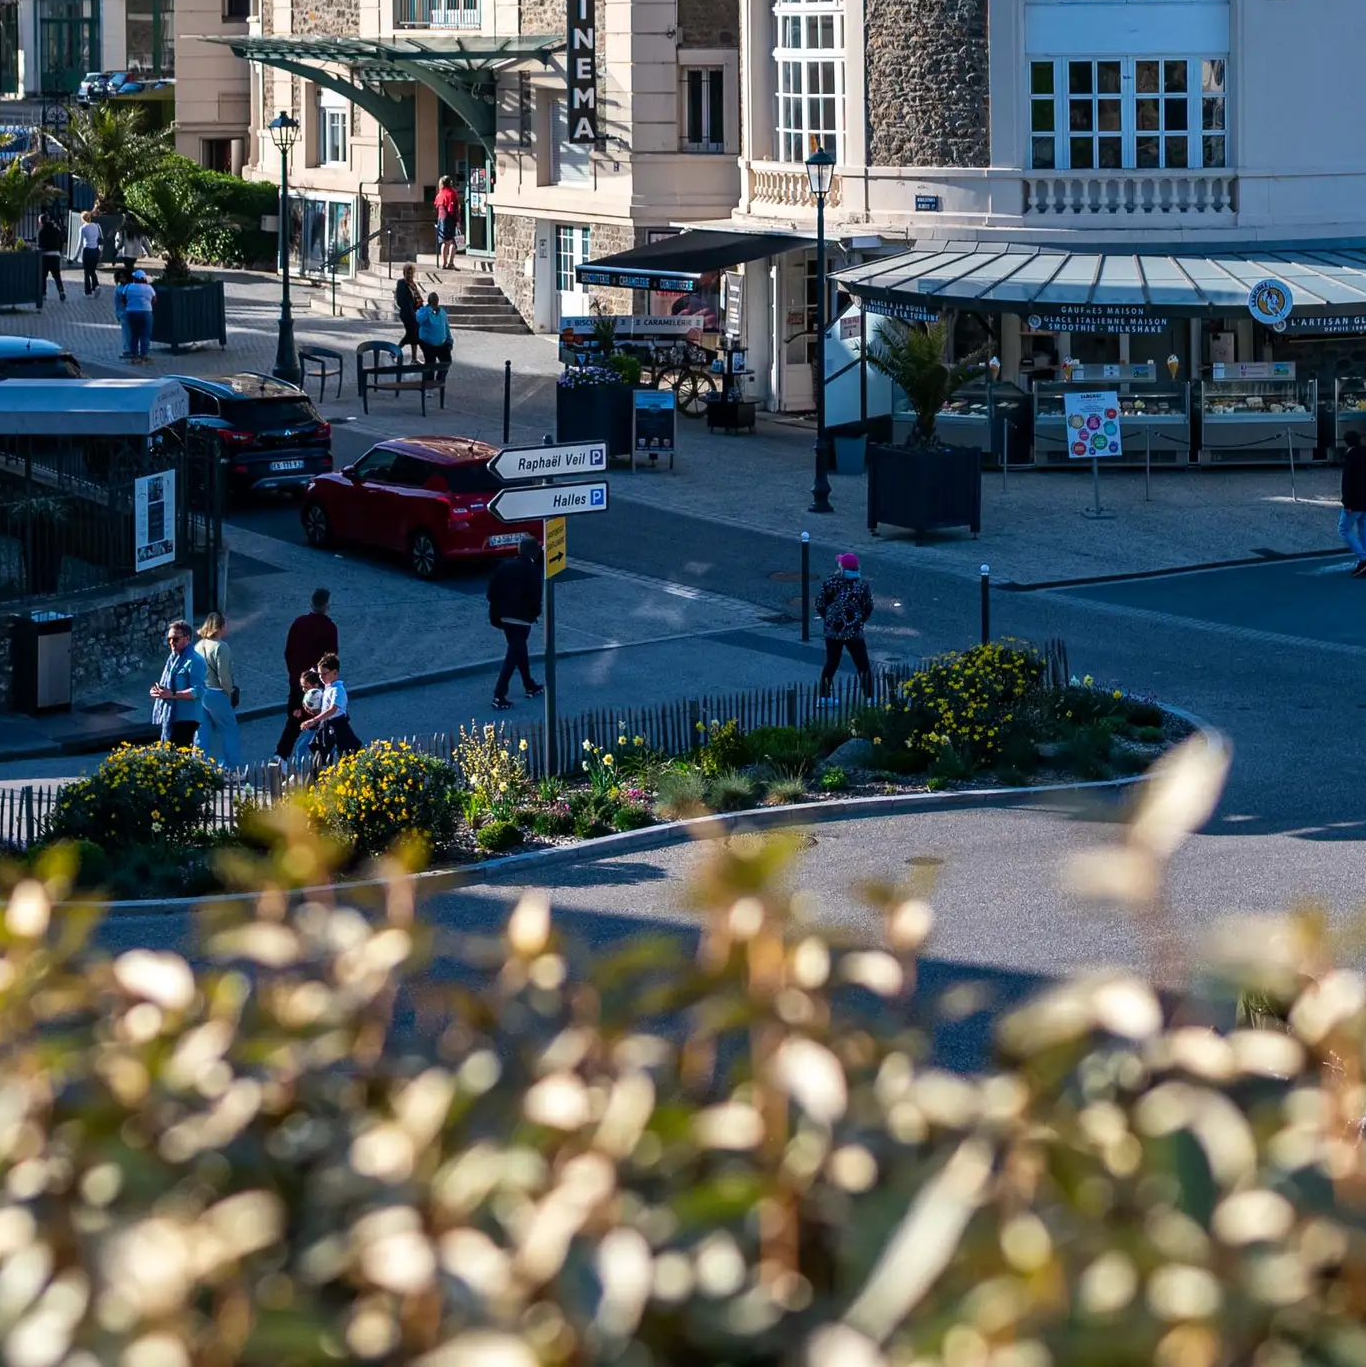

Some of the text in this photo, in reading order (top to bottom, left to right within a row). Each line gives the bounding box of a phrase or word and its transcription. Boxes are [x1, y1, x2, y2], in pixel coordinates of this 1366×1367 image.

[1107, 307, 1144, 315] MAISON
[1043, 315, 1168, 326] GLACE ITALIENNE MAISON
[1291, 317, 1349, 327] L'ARTISAN
[1048, 323, 1096, 332] SMOOTHIE
[1108, 324, 1163, 333] MILKSHAKE
[518, 454, 561, 472] Raphaël
[565, 452, 586, 466] Veil
[553, 494, 586, 508] Halles
